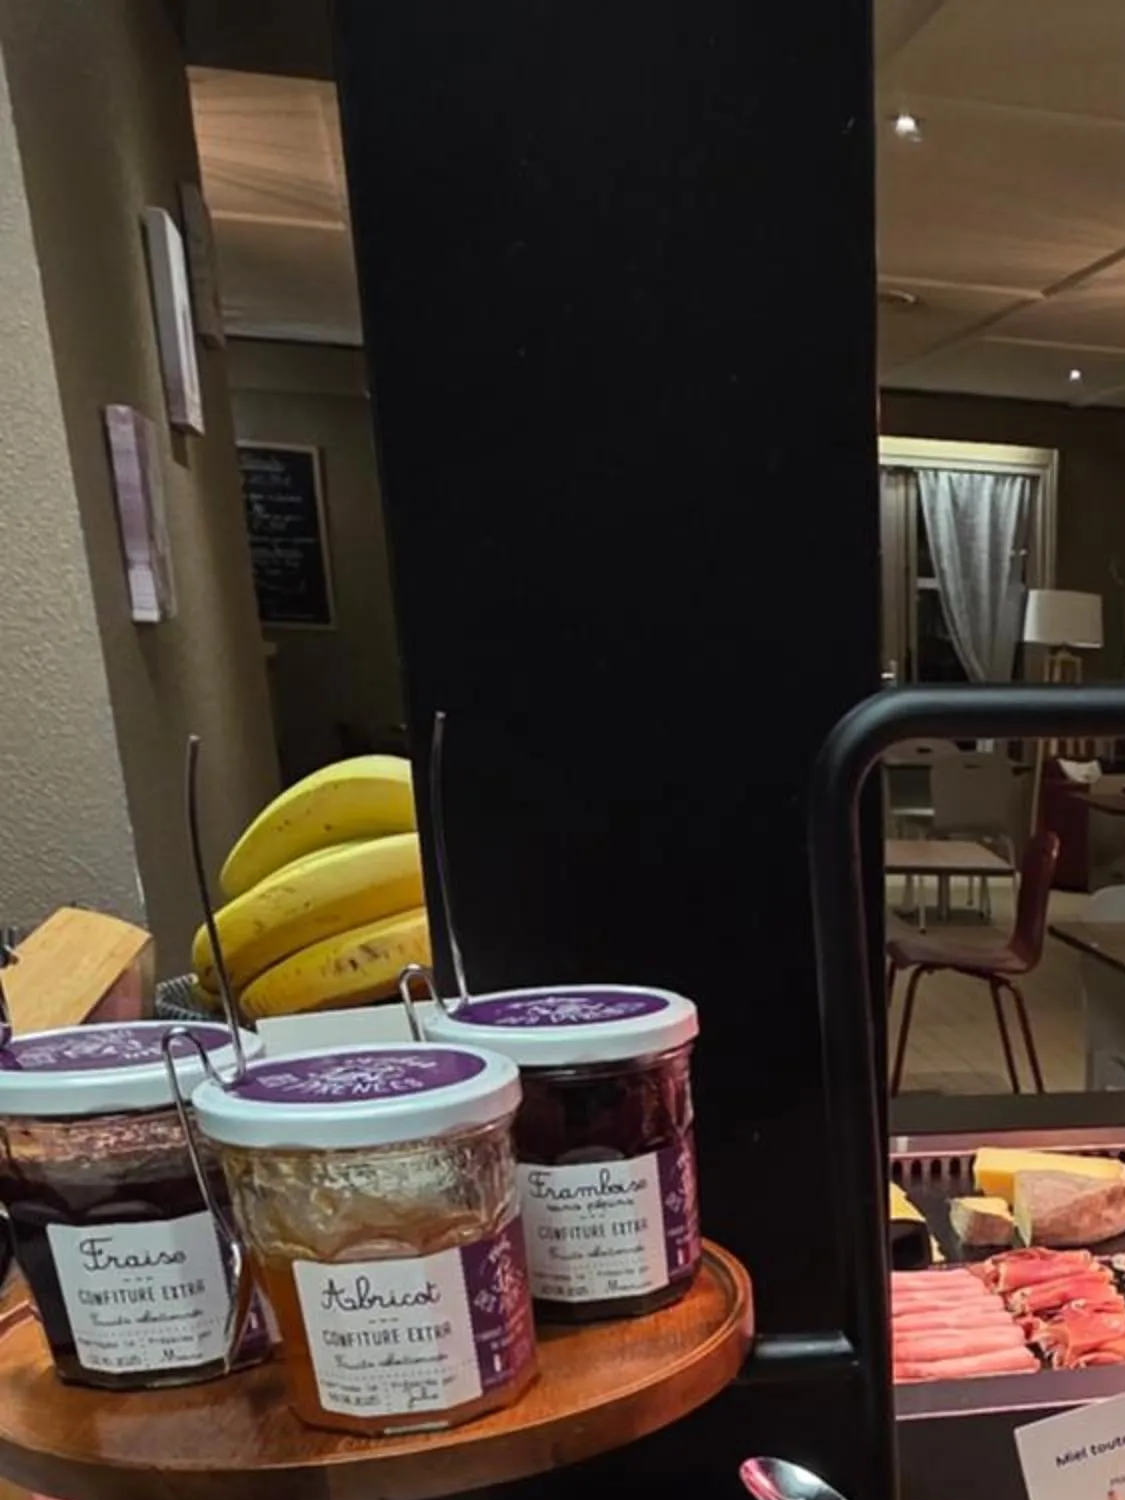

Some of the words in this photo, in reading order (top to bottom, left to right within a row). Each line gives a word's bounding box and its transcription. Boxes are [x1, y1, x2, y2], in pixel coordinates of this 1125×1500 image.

[79, 1237, 187, 1272] Fraise
[78, 1286, 154, 1305] CONFITURE
[161, 1279, 205, 1300] EXTRA
[321, 1275, 441, 1311] Abricot
[322, 1328, 399, 1349] CONFITURE
[407, 1321, 452, 1344] EXTRA
[1056, 1447, 1087, 1468] Miel
